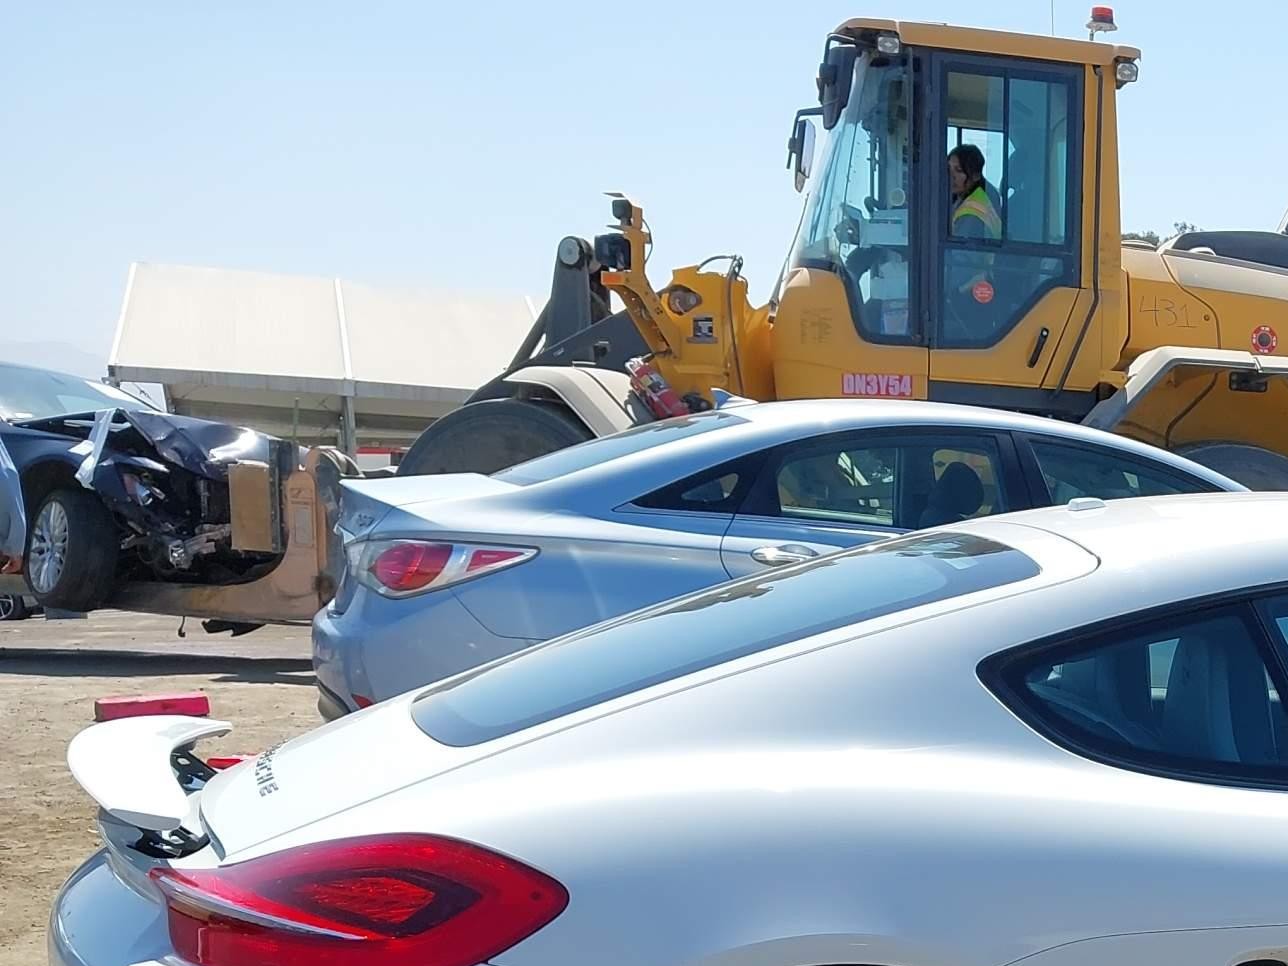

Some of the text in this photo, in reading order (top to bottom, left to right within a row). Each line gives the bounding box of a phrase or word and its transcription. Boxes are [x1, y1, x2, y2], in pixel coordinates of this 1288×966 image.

[1138, 296, 1197, 328] 431
[842, 373, 912, 396] DN3Y54
[255, 741, 281, 797] SCHE
